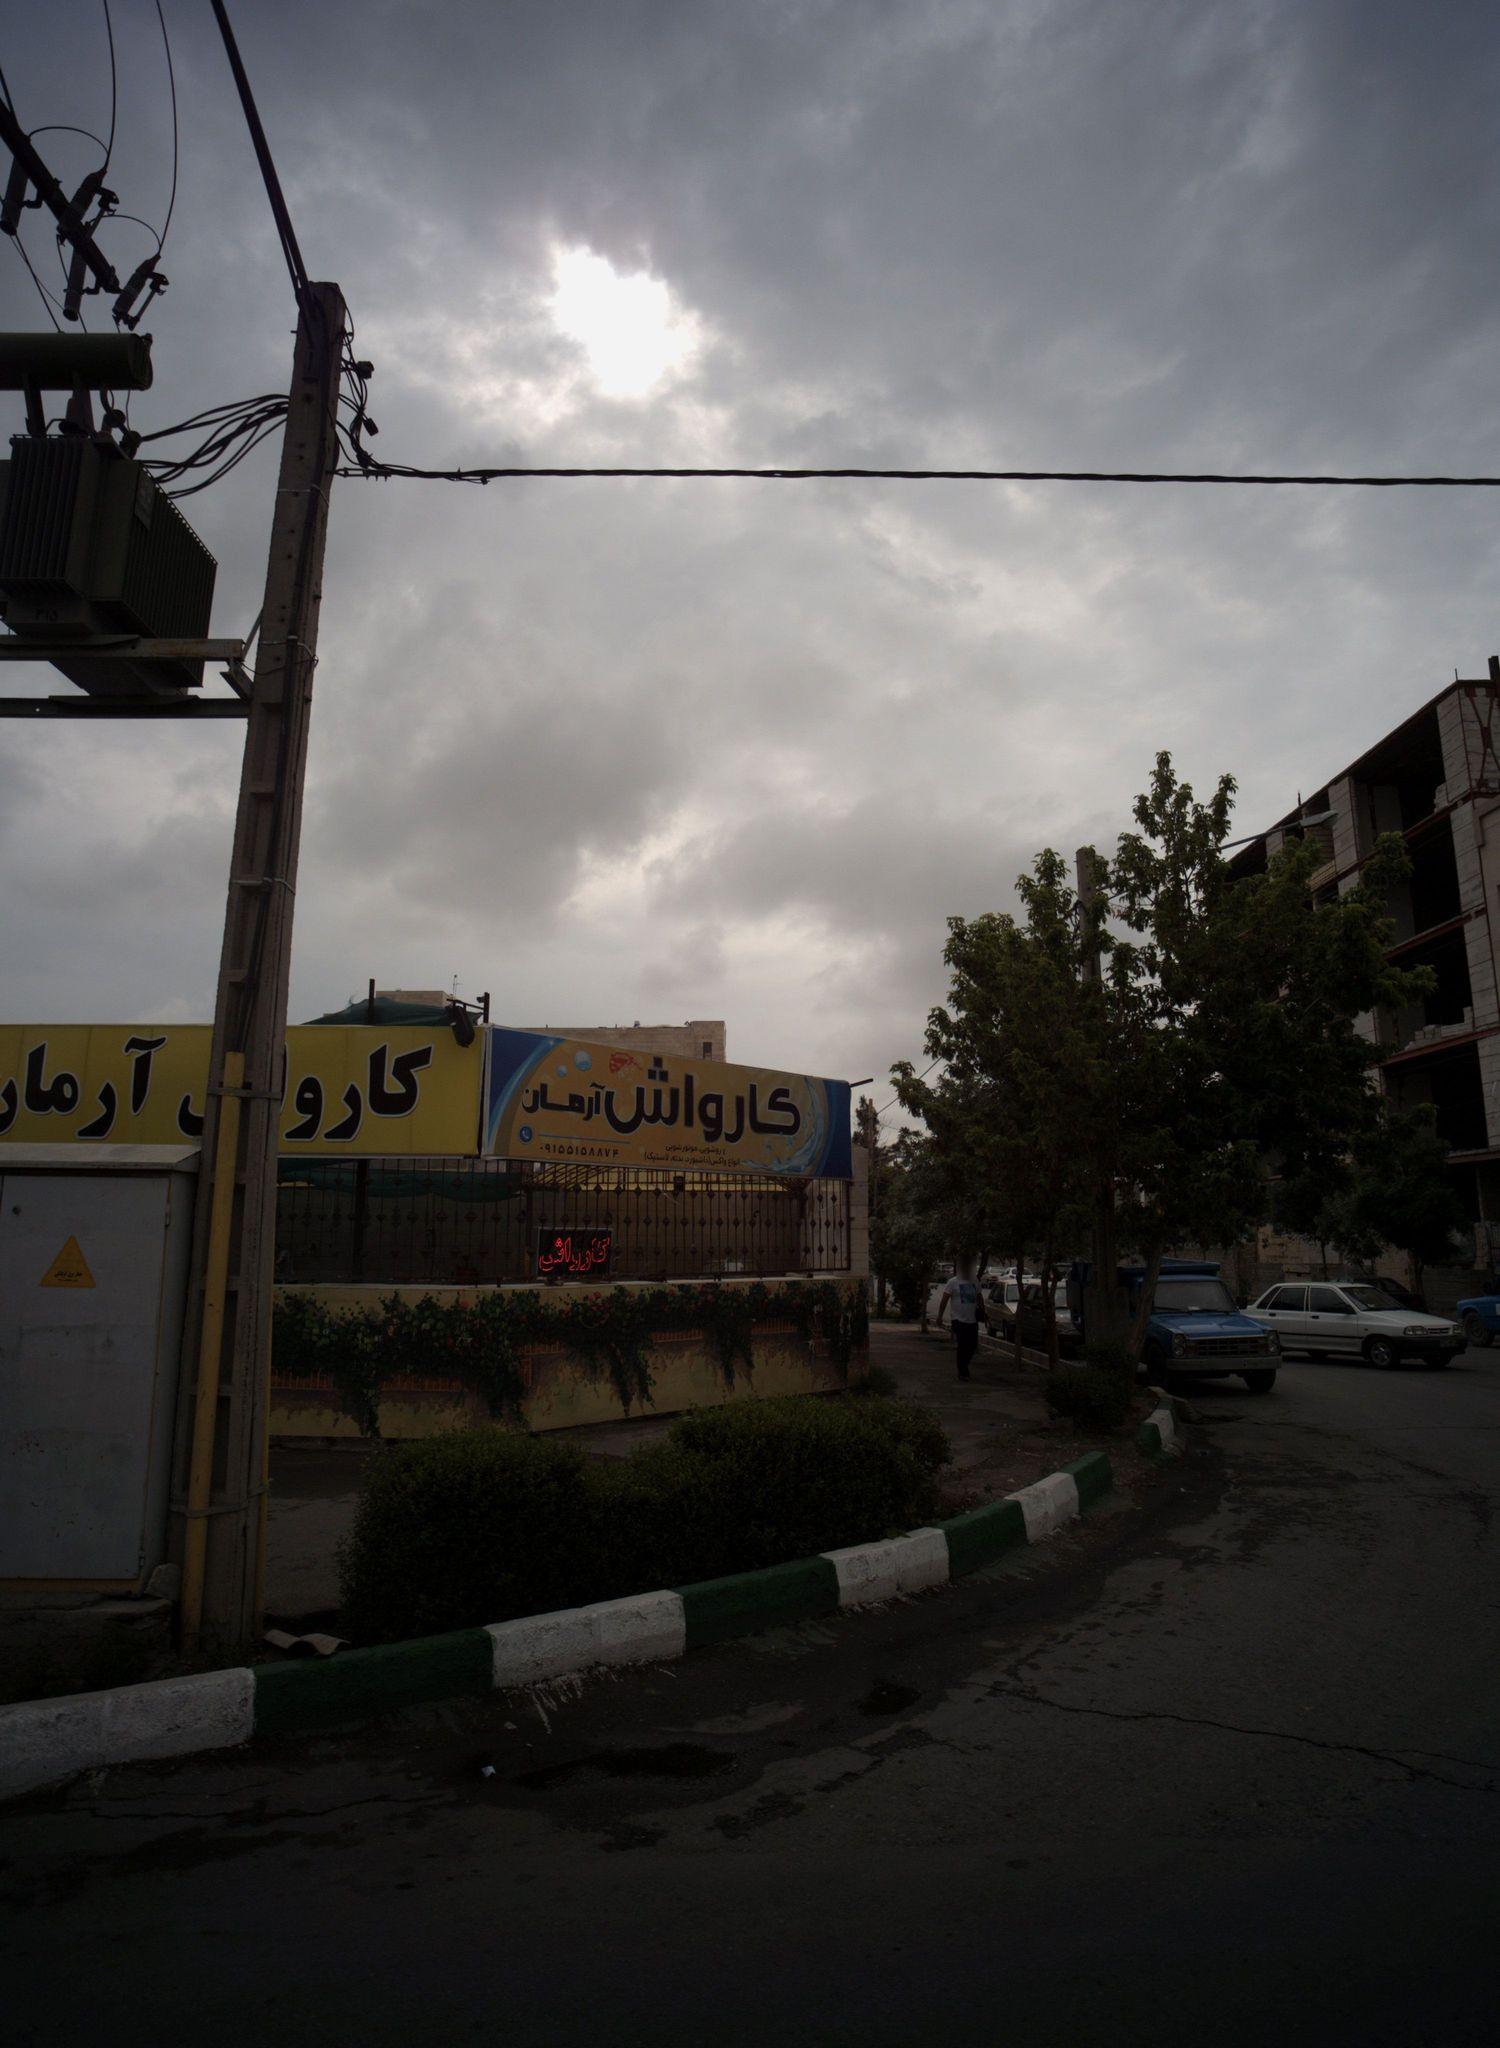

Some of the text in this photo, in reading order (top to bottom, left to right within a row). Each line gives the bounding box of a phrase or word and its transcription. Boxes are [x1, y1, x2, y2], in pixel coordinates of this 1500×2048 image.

[177, 1043, 433, 1141] کارو
[522, 1057, 801, 1143] کارواش آرمان
